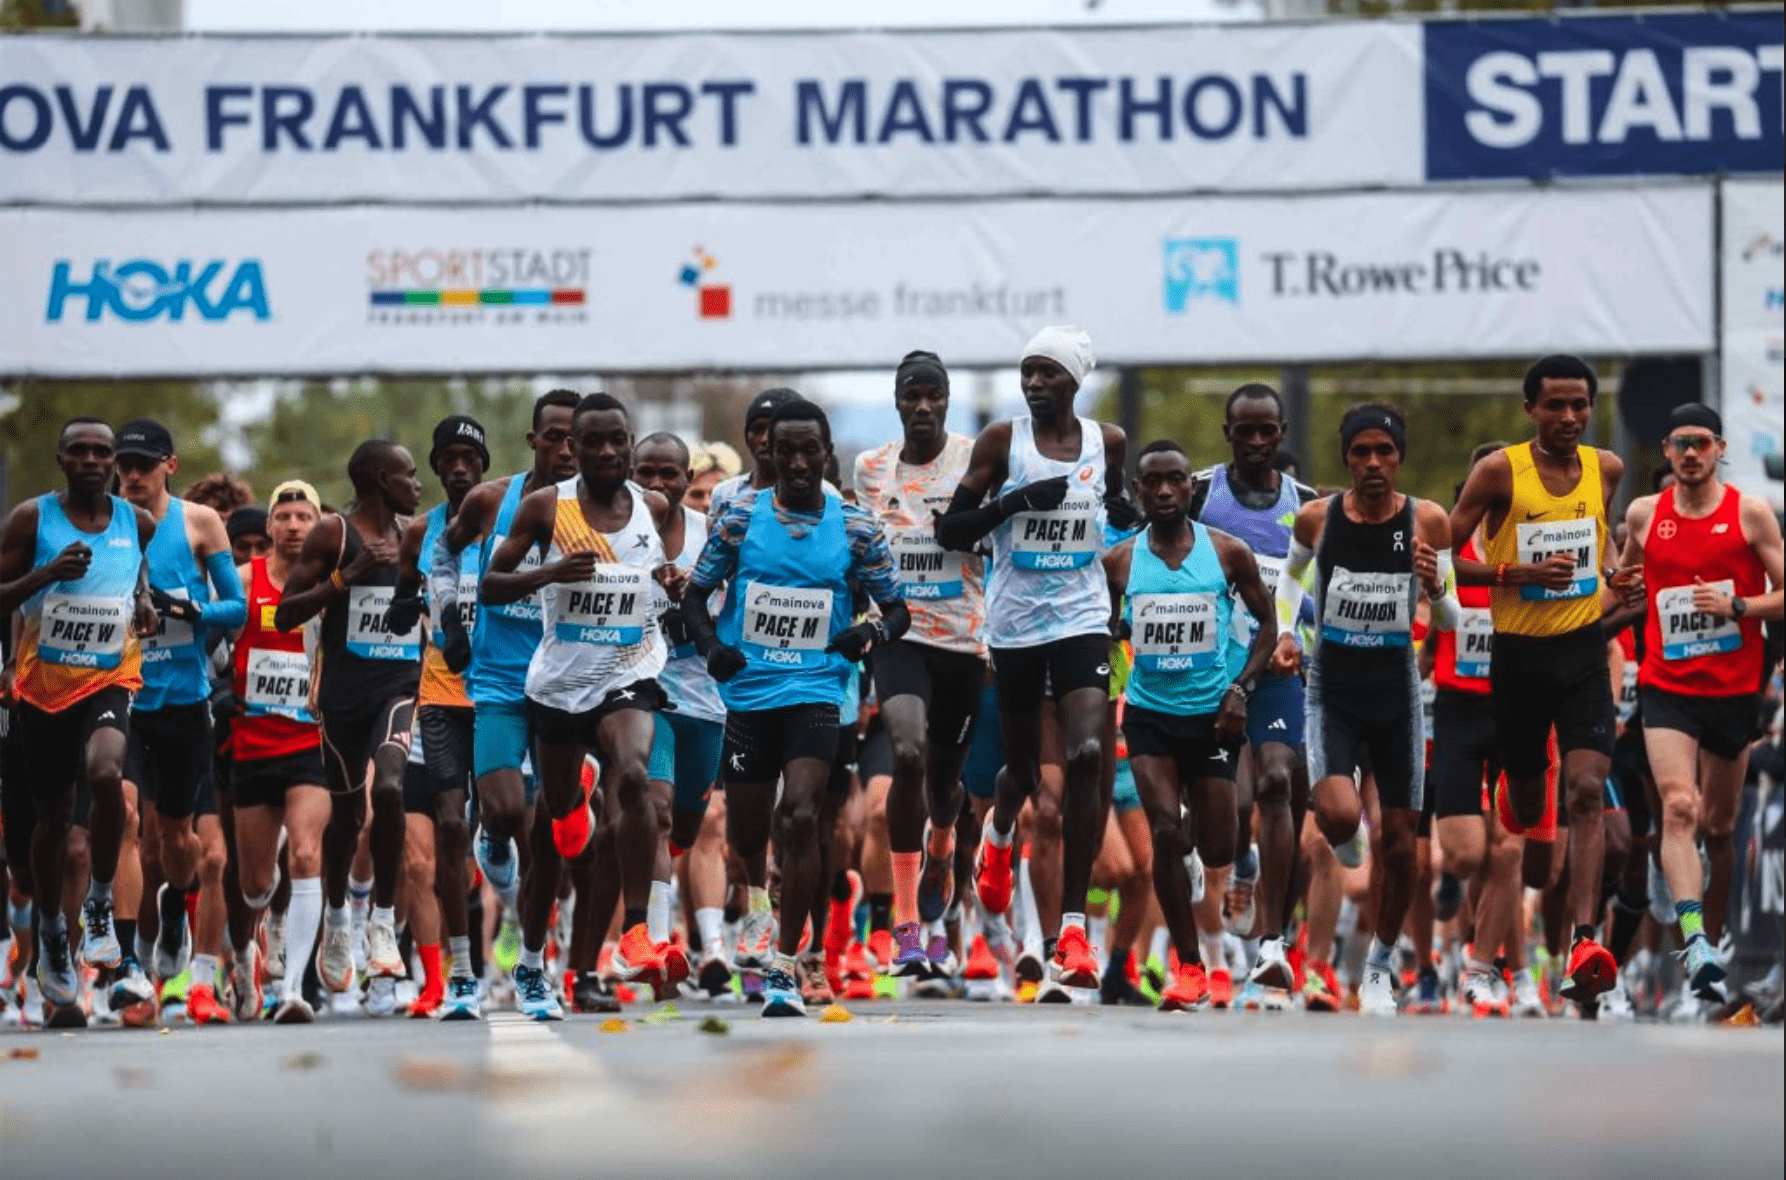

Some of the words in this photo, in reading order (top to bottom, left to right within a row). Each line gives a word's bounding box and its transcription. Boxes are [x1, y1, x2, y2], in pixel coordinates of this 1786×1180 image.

[204, 81, 756, 151] FRANKFURT
[794, 72, 1310, 145] MARATHON
[45, 258, 272, 322] HOKA
[753, 290, 880, 320] messe
[1024, 518, 1069, 541] PACE
[1071, 518, 1087, 541] M
[900, 552, 943, 571] EDWIN
[1034, 554, 1075, 568] HOKA
[68, 604, 120, 617] mainova
[569, 590, 616, 615] PACE
[618, 592, 636, 615] M
[769, 596, 825, 610] mainova
[1155, 603, 1208, 615] mainova
[1337, 599, 1397, 622] FILIMON
[50, 619, 96, 642] PACE
[97, 622, 116, 643] W
[580, 628, 622, 642] HOKA
[754, 612, 799, 638] PACE
[801, 617, 819, 639] M
[1144, 622, 1186, 645] PACE
[1189, 621, 1205, 643] M
[763, 649, 803, 664] HOKA
[1156, 656, 1194, 670] HOKA
[255, 675, 295, 696] PACE
